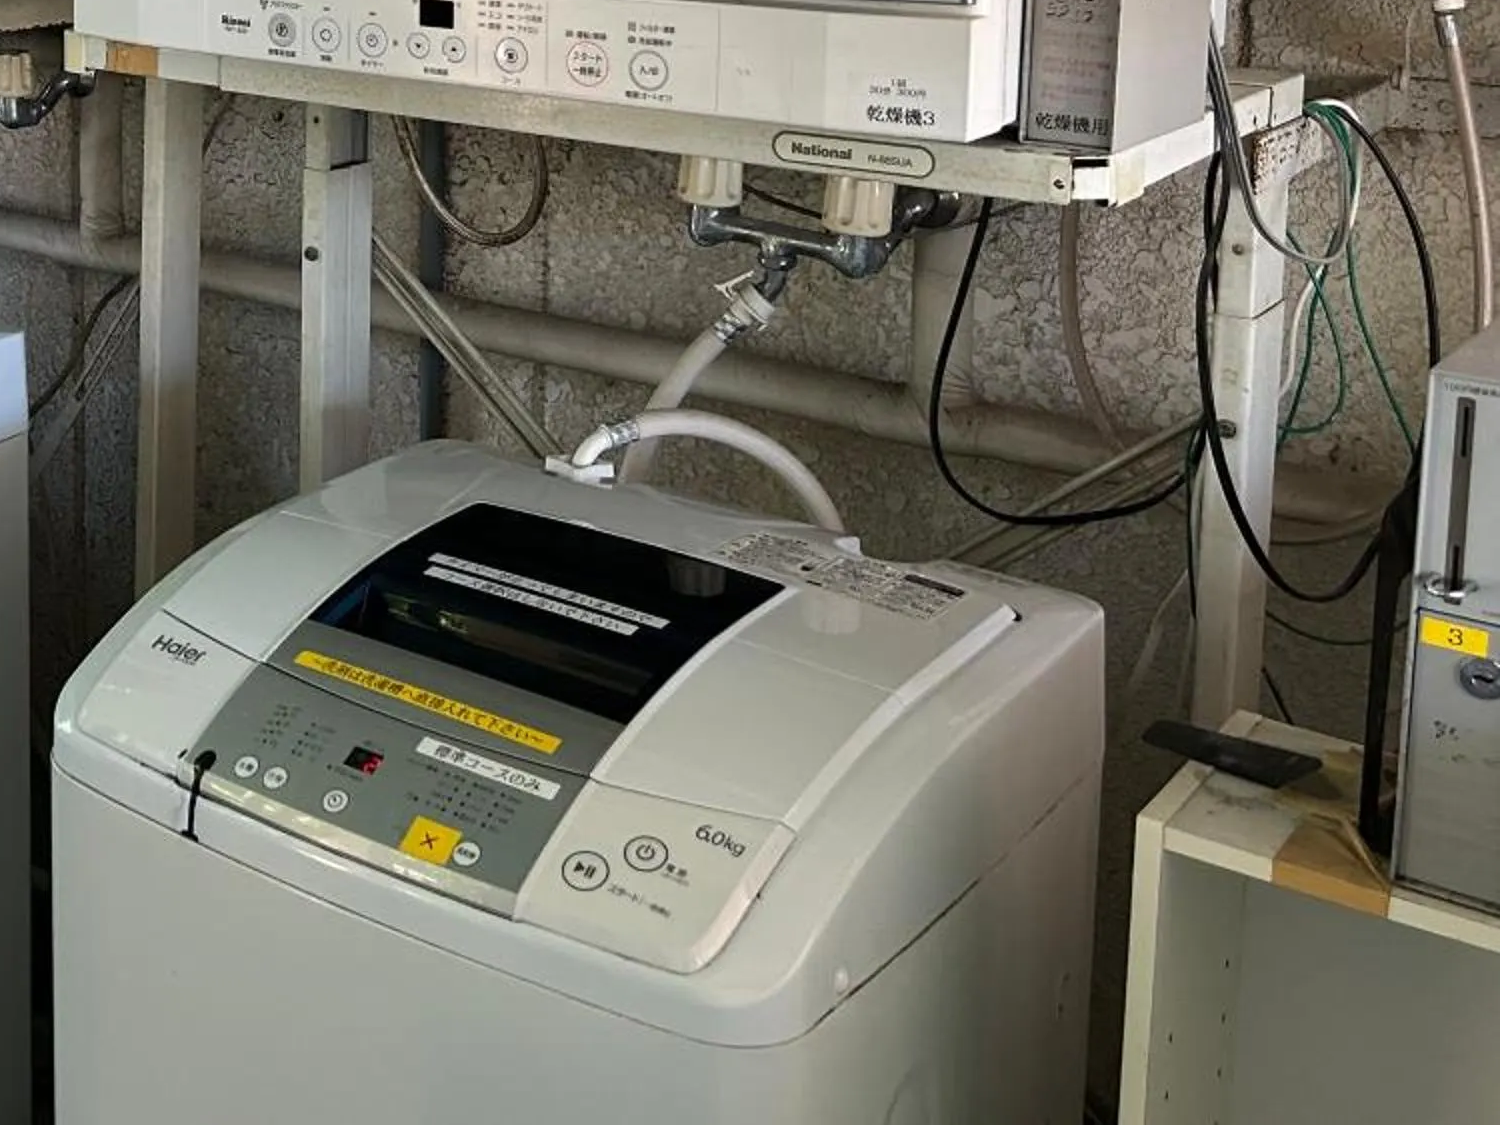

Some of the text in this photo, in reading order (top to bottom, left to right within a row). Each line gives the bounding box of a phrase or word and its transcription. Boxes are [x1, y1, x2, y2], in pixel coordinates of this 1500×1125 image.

[867, 104, 935, 126] 乾燥機3
[1035, 111, 1109, 135] 乾燥機用
[791, 142, 853, 160] National
[1447, 627, 1463, 647] 3
[151, 635, 207, 662] Haier
